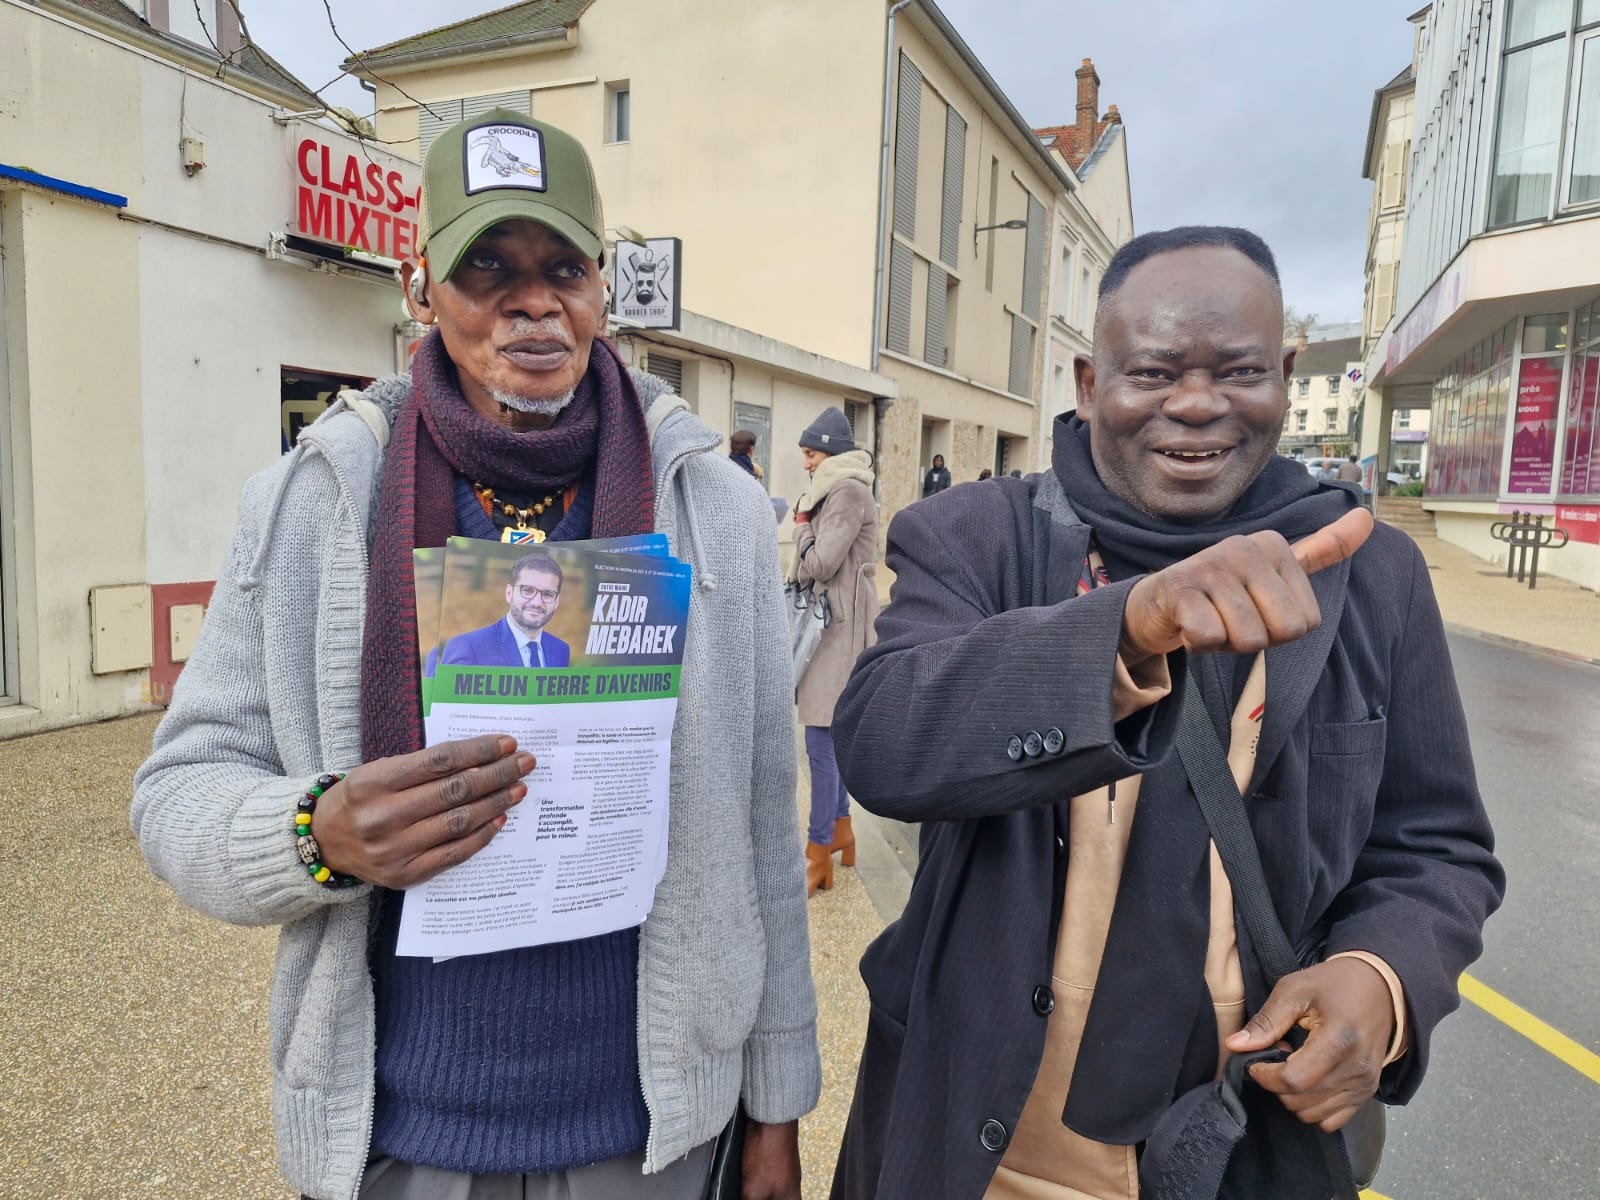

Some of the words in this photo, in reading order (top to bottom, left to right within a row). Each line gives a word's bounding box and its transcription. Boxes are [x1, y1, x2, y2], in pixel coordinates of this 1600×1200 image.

[625, 308, 647, 316] BARBER
[649, 308, 665, 316] SHOP
[1520, 384, 1540, 394] près
[592, 594, 648, 623] KADIR
[585, 624, 678, 654] MEBAREK
[454, 673, 528, 696] MELUN
[536, 674, 590, 695] TERRE
[595, 672, 672, 695] D'AVENIRS
[540, 804, 584, 812] transformation
[538, 812, 567, 820] profonde
[556, 826, 578, 834] change
[535, 834, 550, 842] pour
